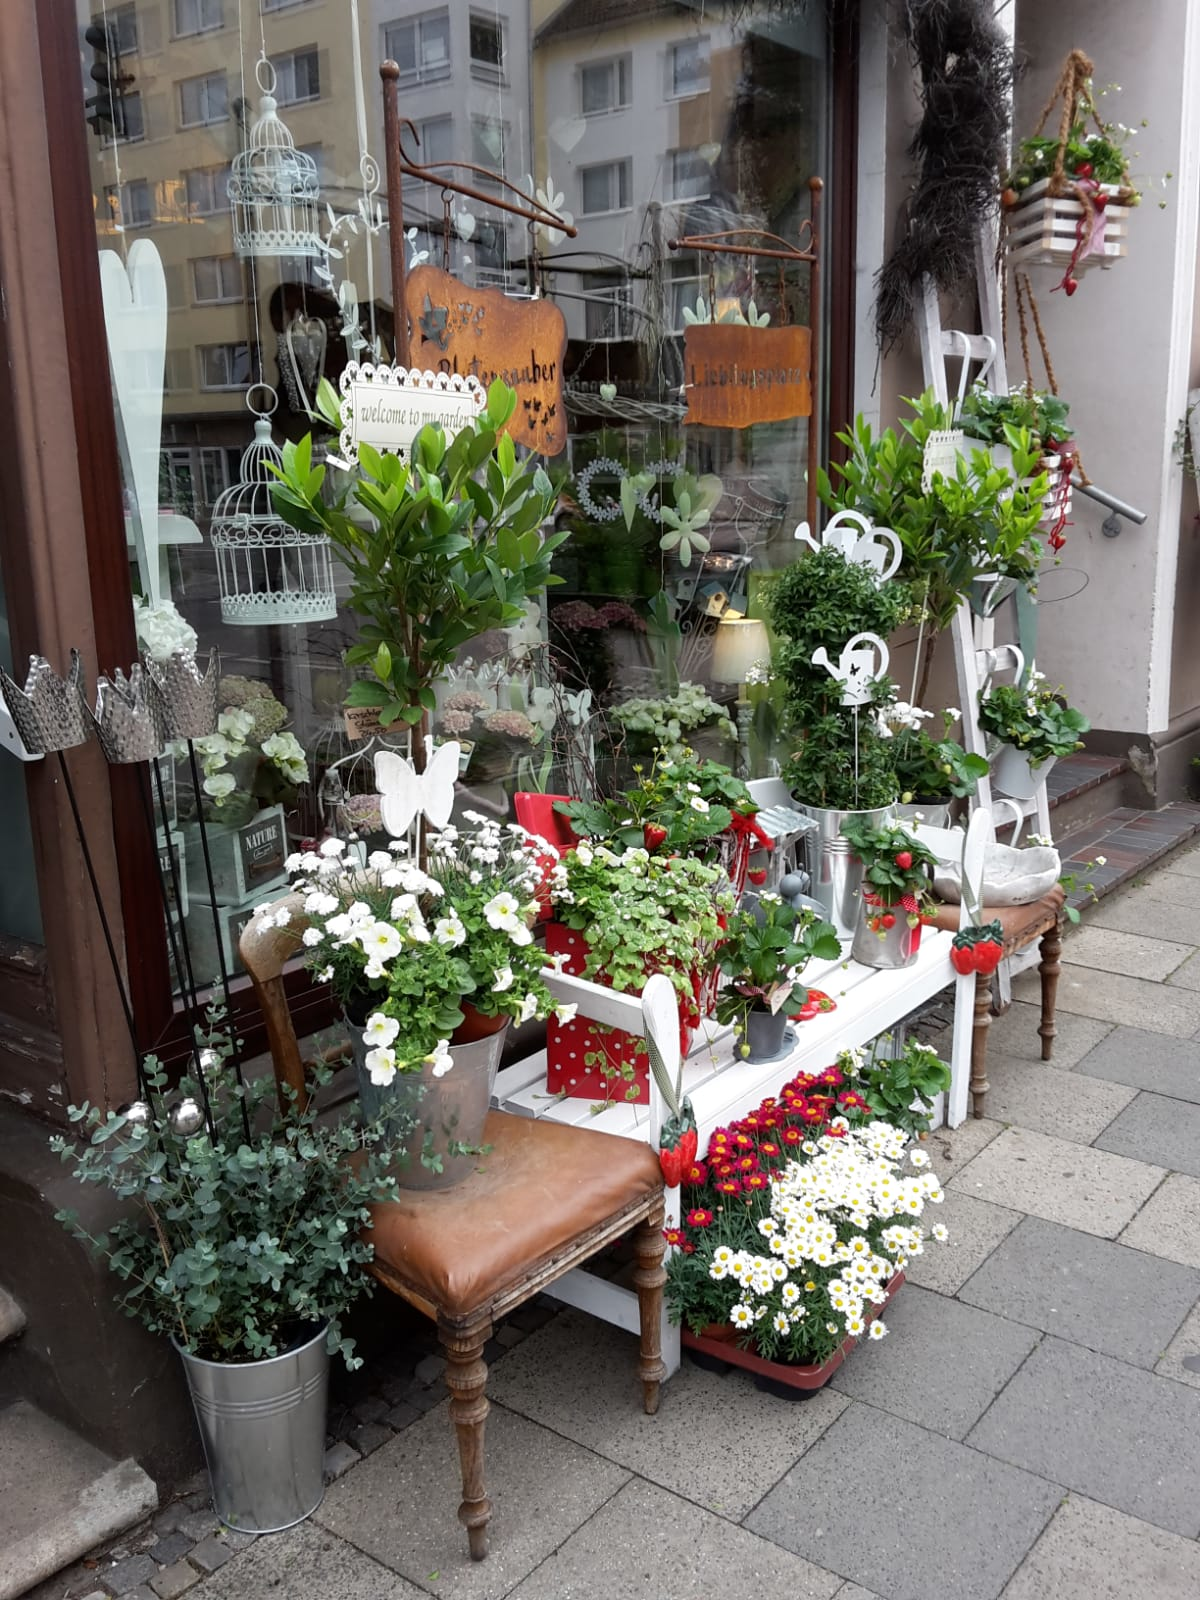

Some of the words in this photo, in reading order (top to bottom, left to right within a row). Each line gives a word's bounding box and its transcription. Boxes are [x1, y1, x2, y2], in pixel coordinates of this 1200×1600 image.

[361, 398, 407, 425] welcome
[409, 407, 420, 426] to
[439, 406, 470, 430] garden
[245, 824, 278, 851] NATURE
